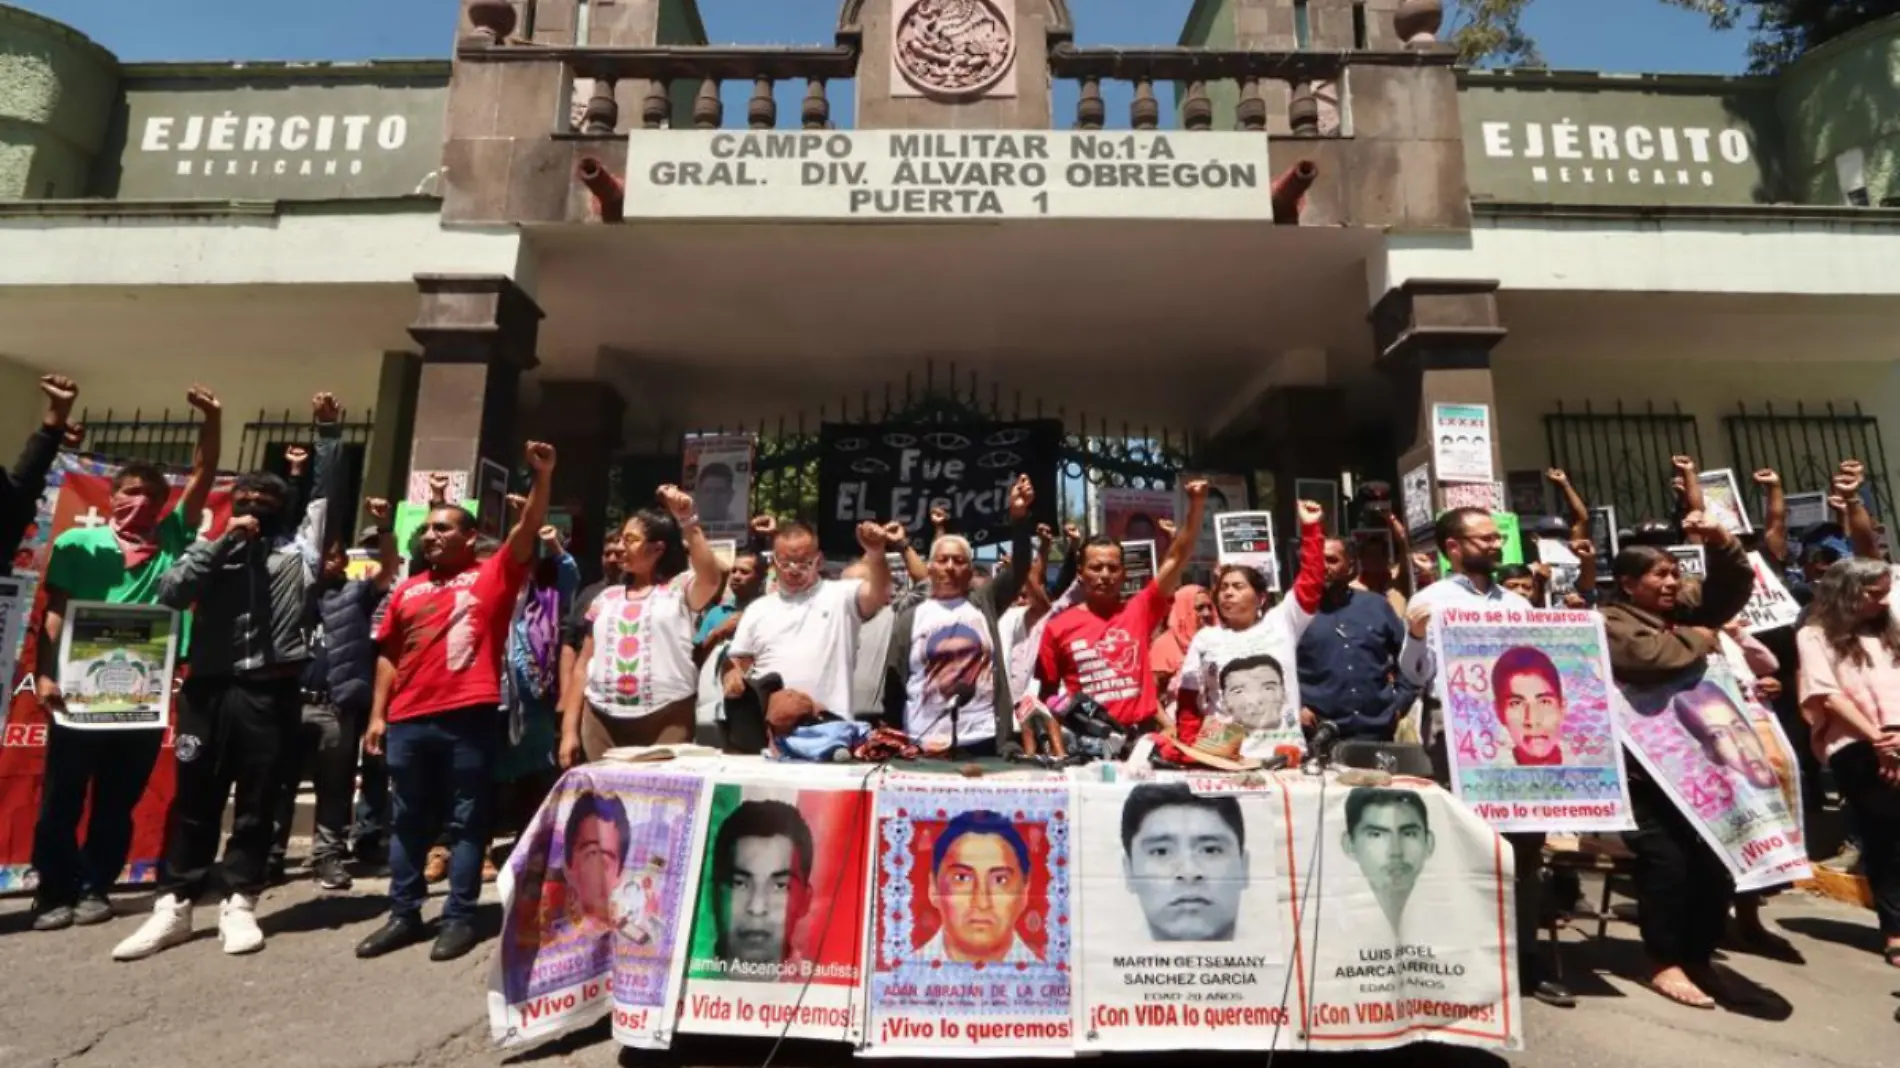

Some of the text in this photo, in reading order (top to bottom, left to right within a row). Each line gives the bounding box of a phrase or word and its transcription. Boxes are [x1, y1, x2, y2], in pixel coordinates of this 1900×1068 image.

[141, 110, 407, 151] EJÉRCITO
[1482, 117, 1750, 164] EJÉRCITO
[709, 133, 853, 159] CAMPO
[889, 134, 1050, 160] MILITAR
[177, 159, 363, 176] MEXICANO
[649, 157, 1257, 188] GRAL. DIV. ÁLVARO OBREGÓN
[1532, 165, 1714, 186] MEXICANO
[849, 189, 1049, 214] PUERTA 1
[899, 448, 966, 484] Fue
[836, 470, 1018, 533] EL Ejércit
[1443, 610, 1482, 626] ¡Vivo
[1485, 612, 1503, 623] se
[1507, 610, 1522, 623] lo
[1451, 663, 1489, 693] 43
[1459, 729, 1498, 760] 43
[1513, 803, 1528, 818] lo
[730, 957, 798, 977] Ascencio
[1112, 954, 1266, 969] MARTÍN GETSEMANY
[1359, 947, 1393, 962] LUIS
[1123, 971, 1258, 985] SÁNCHEZ GARCÍA
[1334, 965, 1396, 979] ABARCA
[990, 984, 1007, 998] DE
[1016, 984, 1034, 998] LA
[520, 993, 576, 1029] ¡Vivo
[581, 983, 599, 1002] lo
[691, 994, 733, 1020] Vida
[737, 997, 755, 1021] lo
[758, 1002, 857, 1028] queremos!
[1090, 1002, 1290, 1030] ¡Con VIDA lo queremos
[1312, 1001, 1350, 1027] ¡Con
[1353, 1000, 1394, 1024] VIDA
[1406, 997, 1496, 1024] queremos!
[881, 1017, 1074, 1044] ¡Vivo lo queremos!
